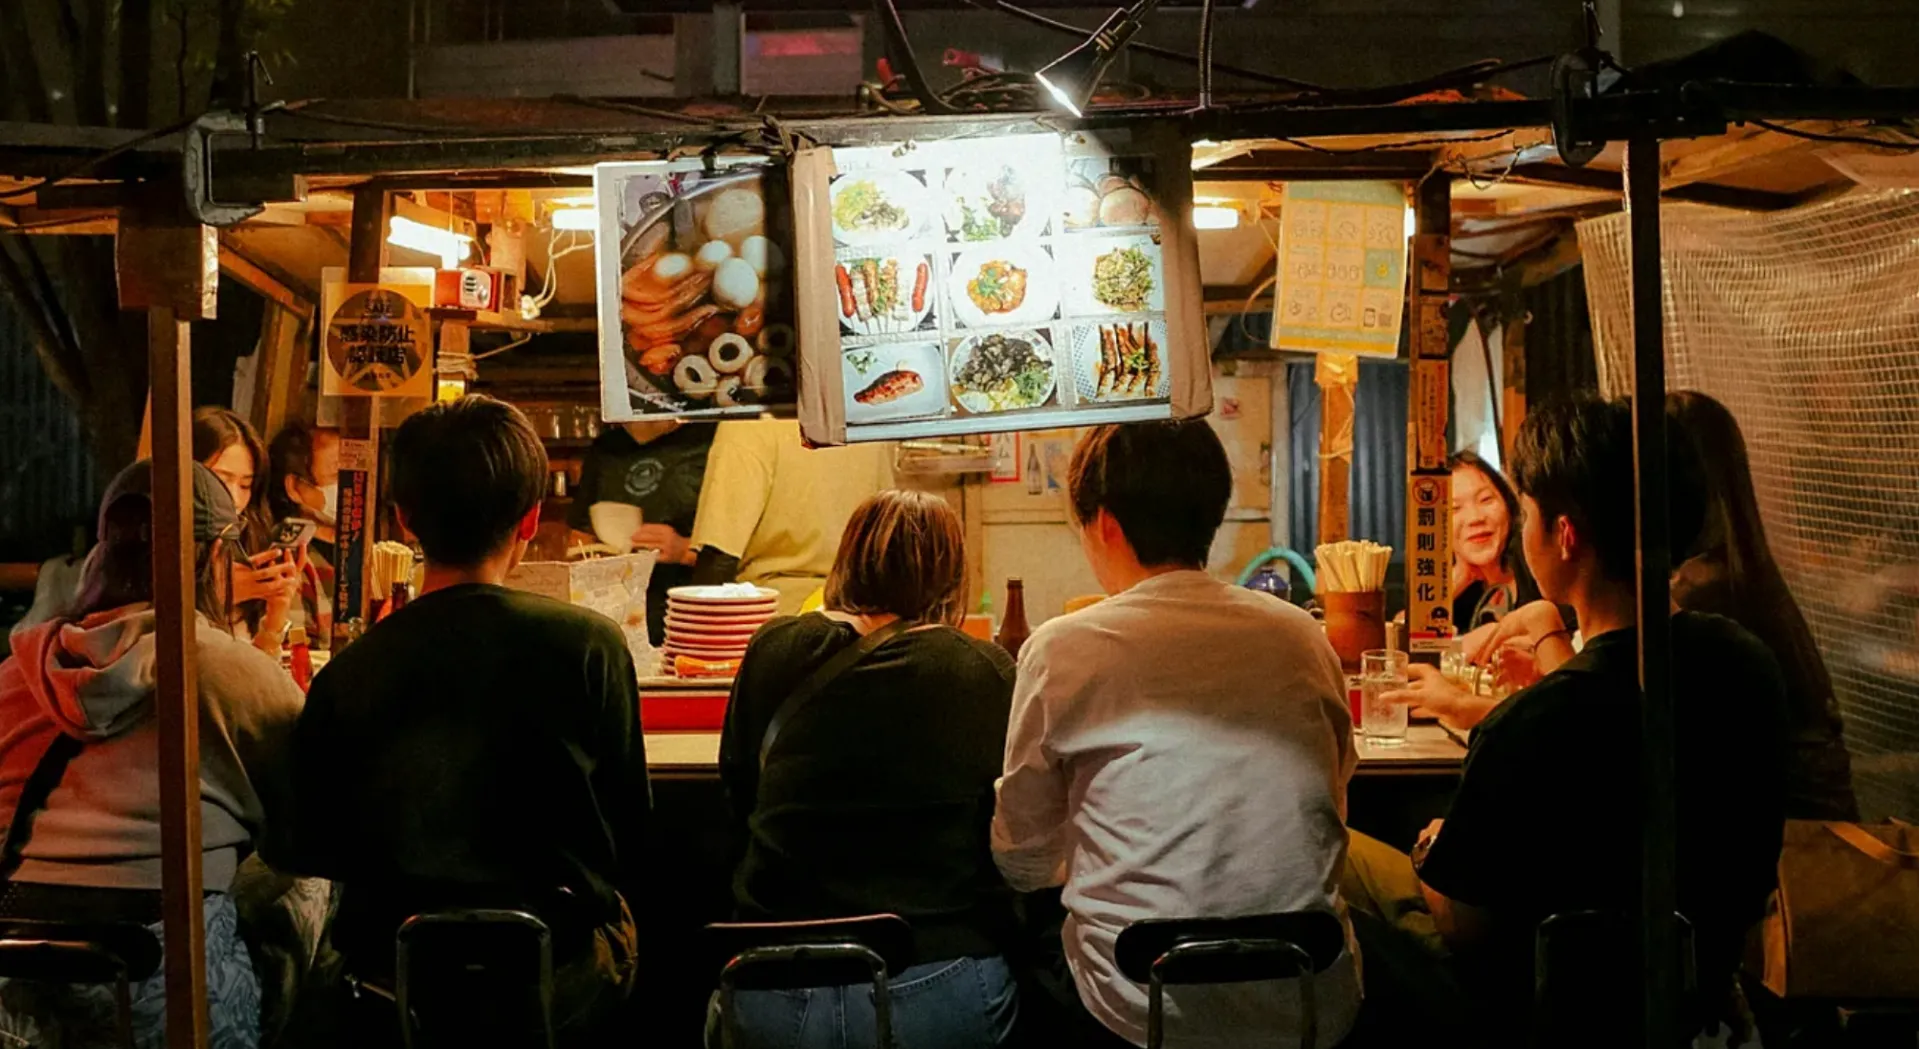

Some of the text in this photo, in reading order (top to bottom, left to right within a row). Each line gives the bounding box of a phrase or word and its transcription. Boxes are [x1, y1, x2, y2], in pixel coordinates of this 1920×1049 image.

[340, 324, 416, 343] 感染防止
[1417, 508, 1435, 602] 罰則強化
